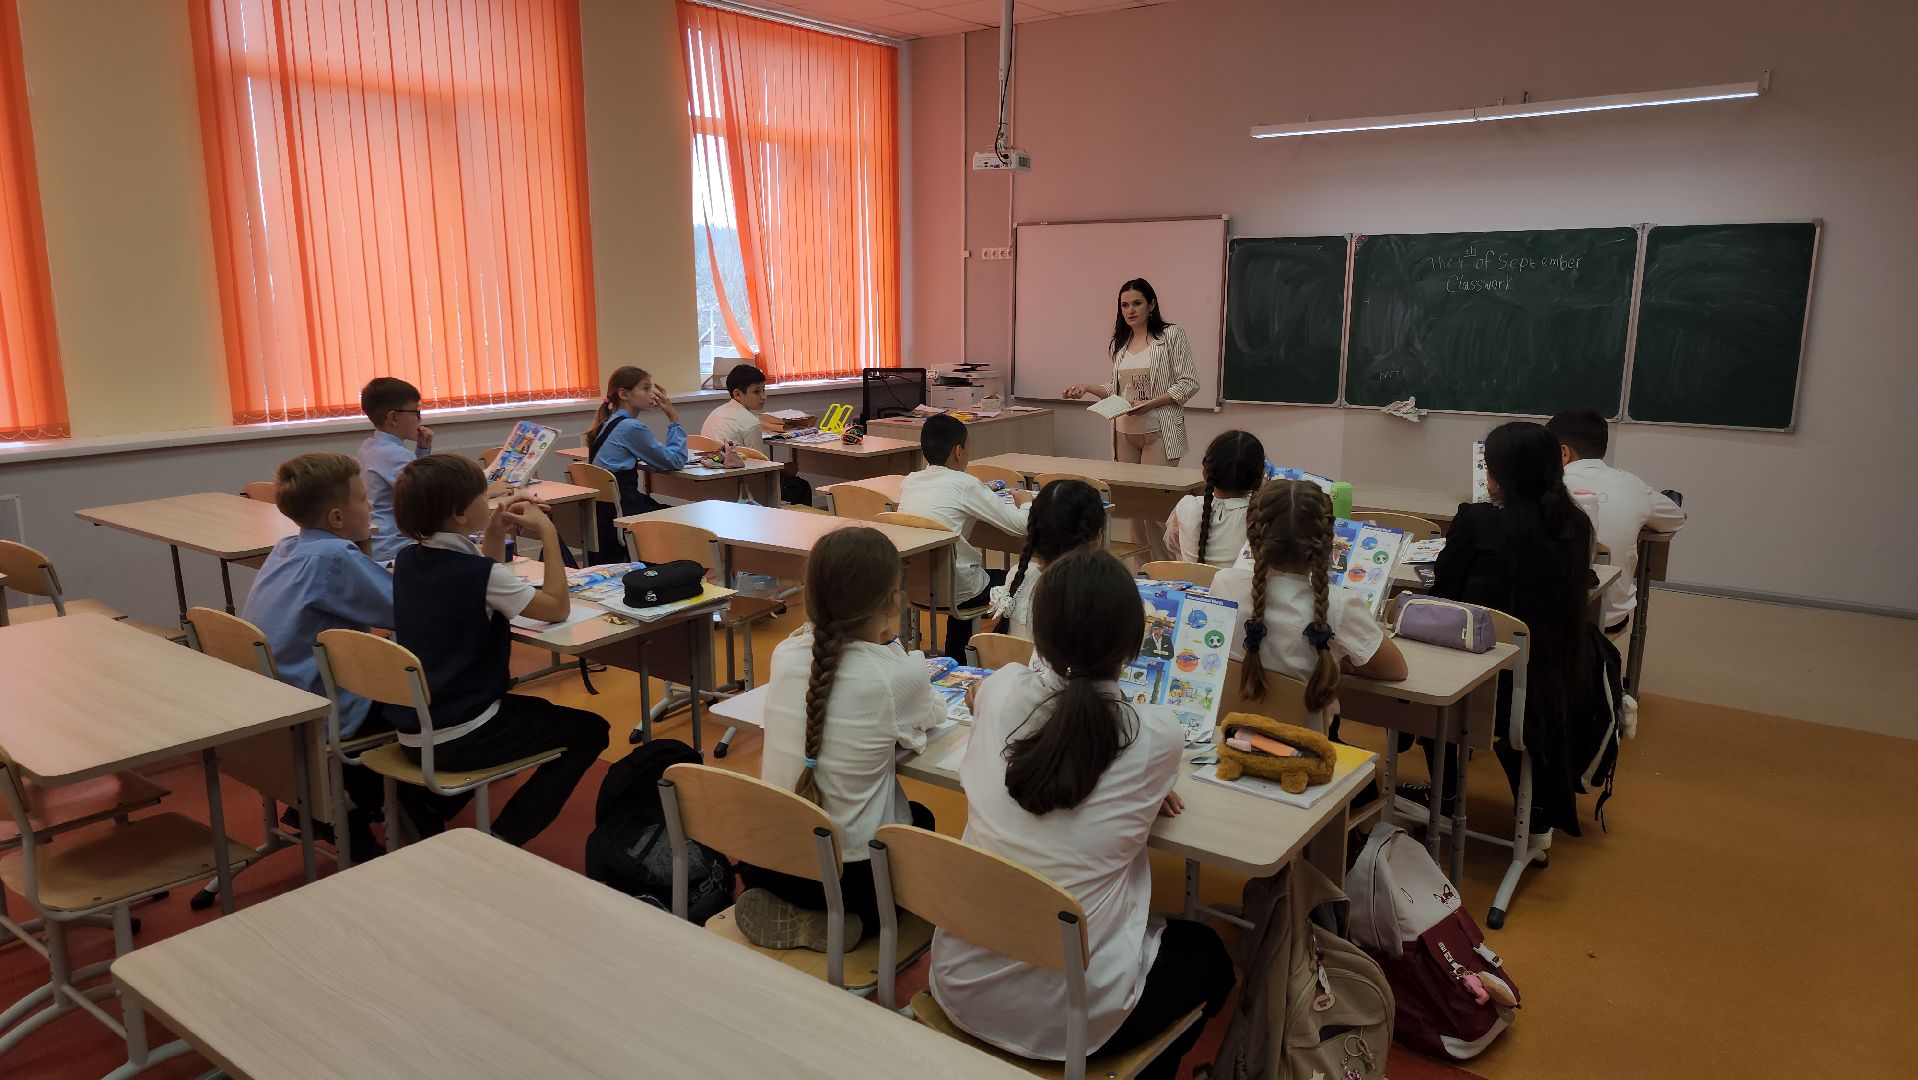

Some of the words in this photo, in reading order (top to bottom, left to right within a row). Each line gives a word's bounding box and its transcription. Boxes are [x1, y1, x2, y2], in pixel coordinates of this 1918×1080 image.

[1425, 256, 1453, 271] The
[1475, 250, 1495, 270] of
[1498, 253, 1582, 272] September
[1446, 275, 1513, 293] Classwork
